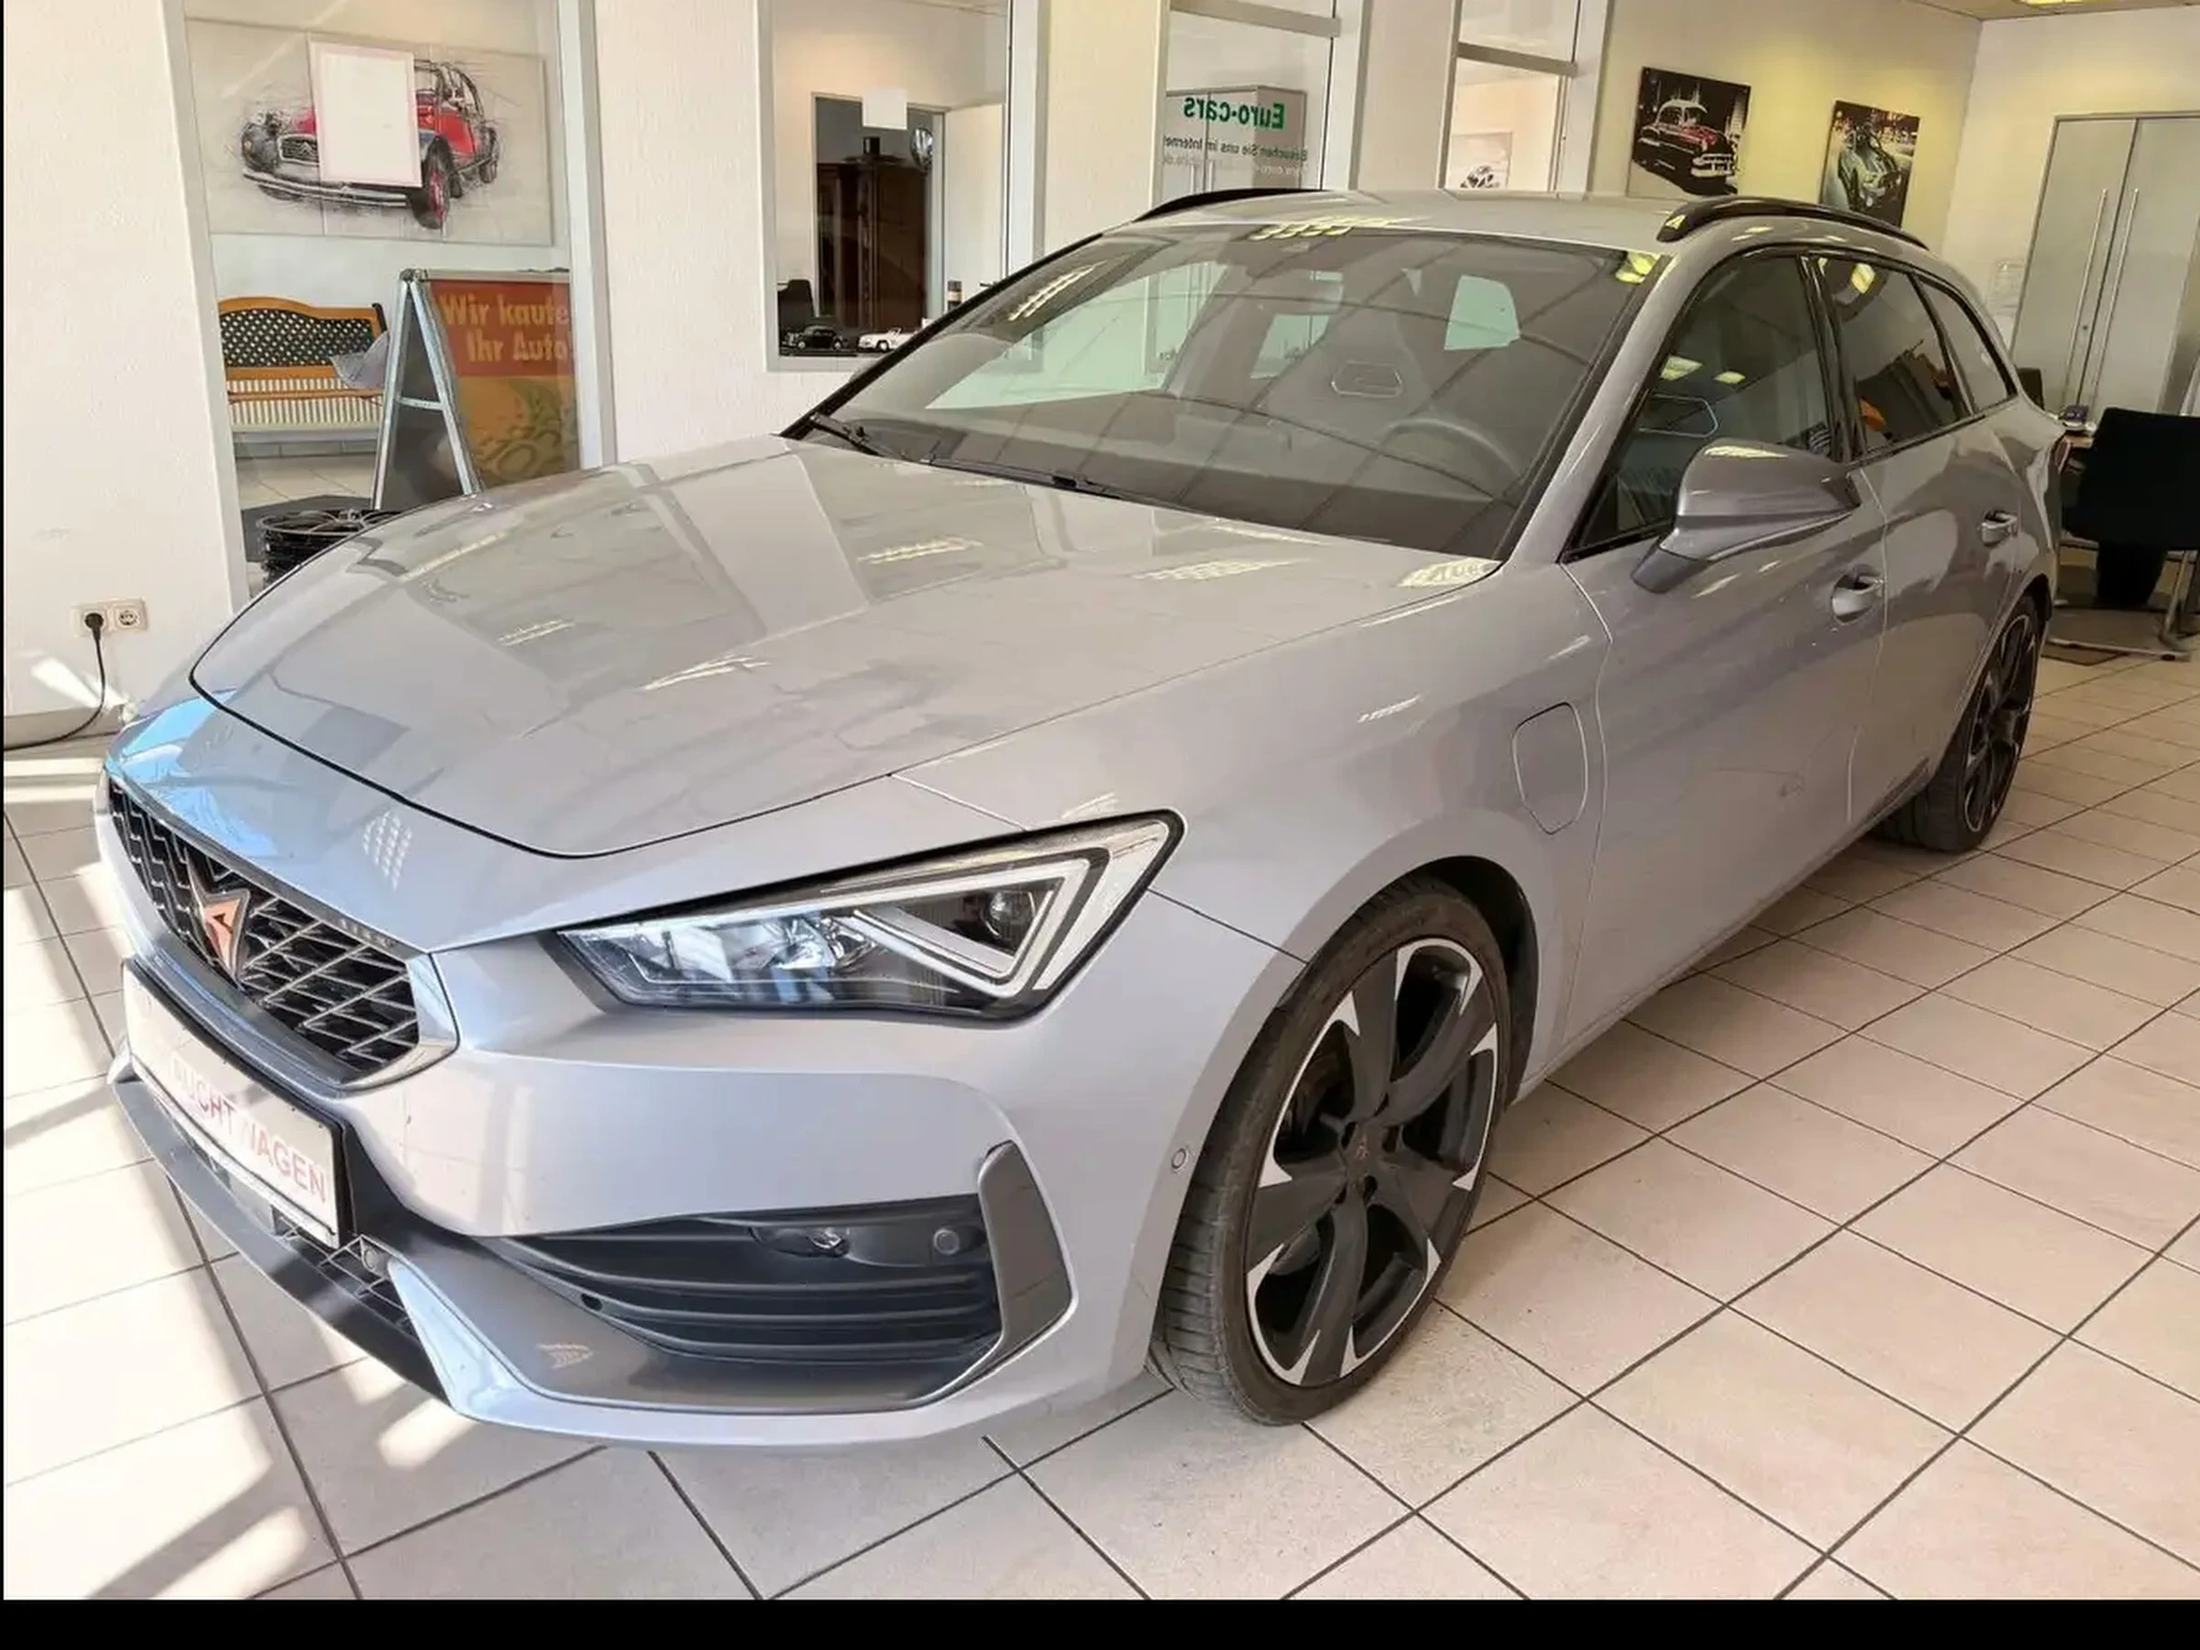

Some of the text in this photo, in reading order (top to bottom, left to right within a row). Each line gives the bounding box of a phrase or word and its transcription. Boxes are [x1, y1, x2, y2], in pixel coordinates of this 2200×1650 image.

[439, 293, 489, 325] Wir
[466, 327, 567, 362] Ihr Auto
